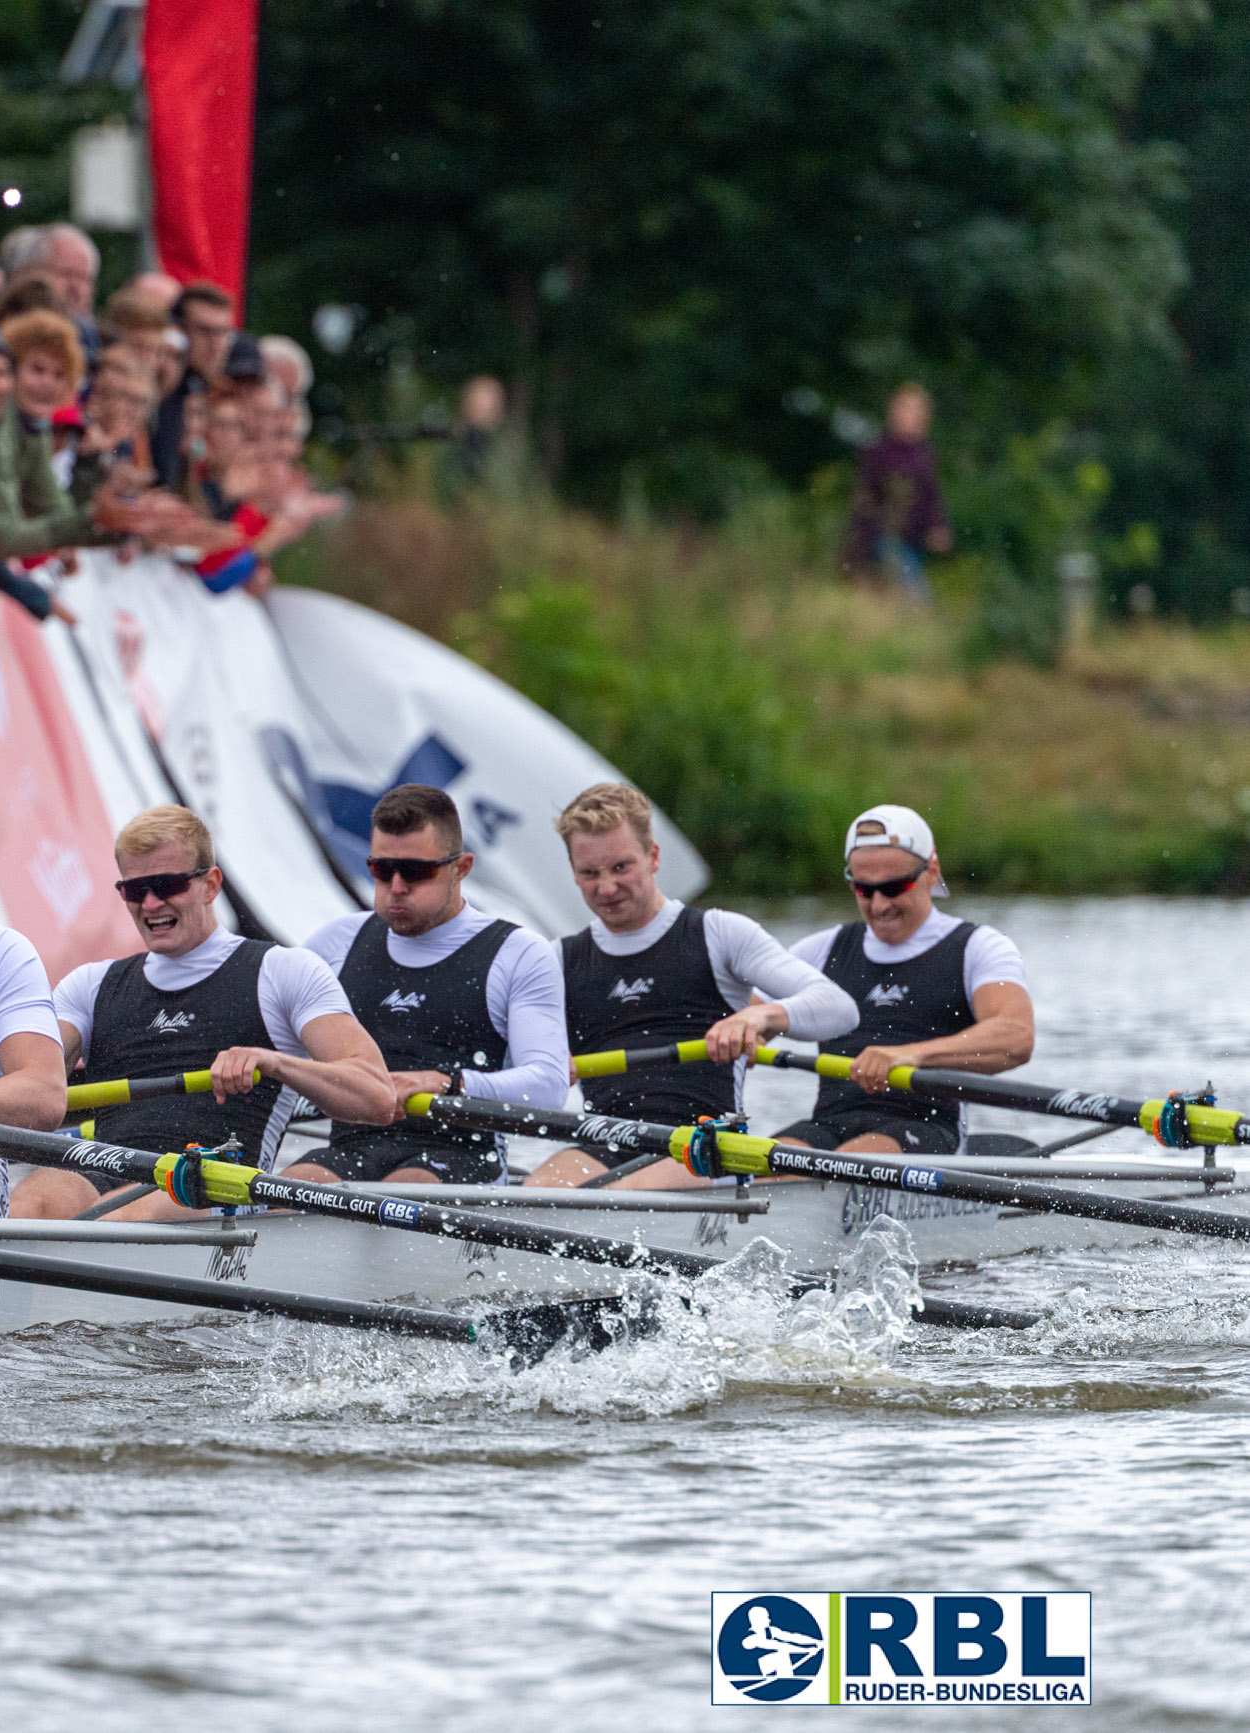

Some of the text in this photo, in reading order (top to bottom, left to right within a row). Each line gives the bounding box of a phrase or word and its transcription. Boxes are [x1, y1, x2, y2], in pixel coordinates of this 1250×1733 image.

[772, 1151, 938, 1187] STARK. SCHNELL. GUT. RBL
[255, 1181, 294, 1201] STARK.
[295, 1189, 348, 1211] SCHNELL.
[350, 1199, 376, 1215] GUT.
[384, 1202, 414, 1220] RBL
